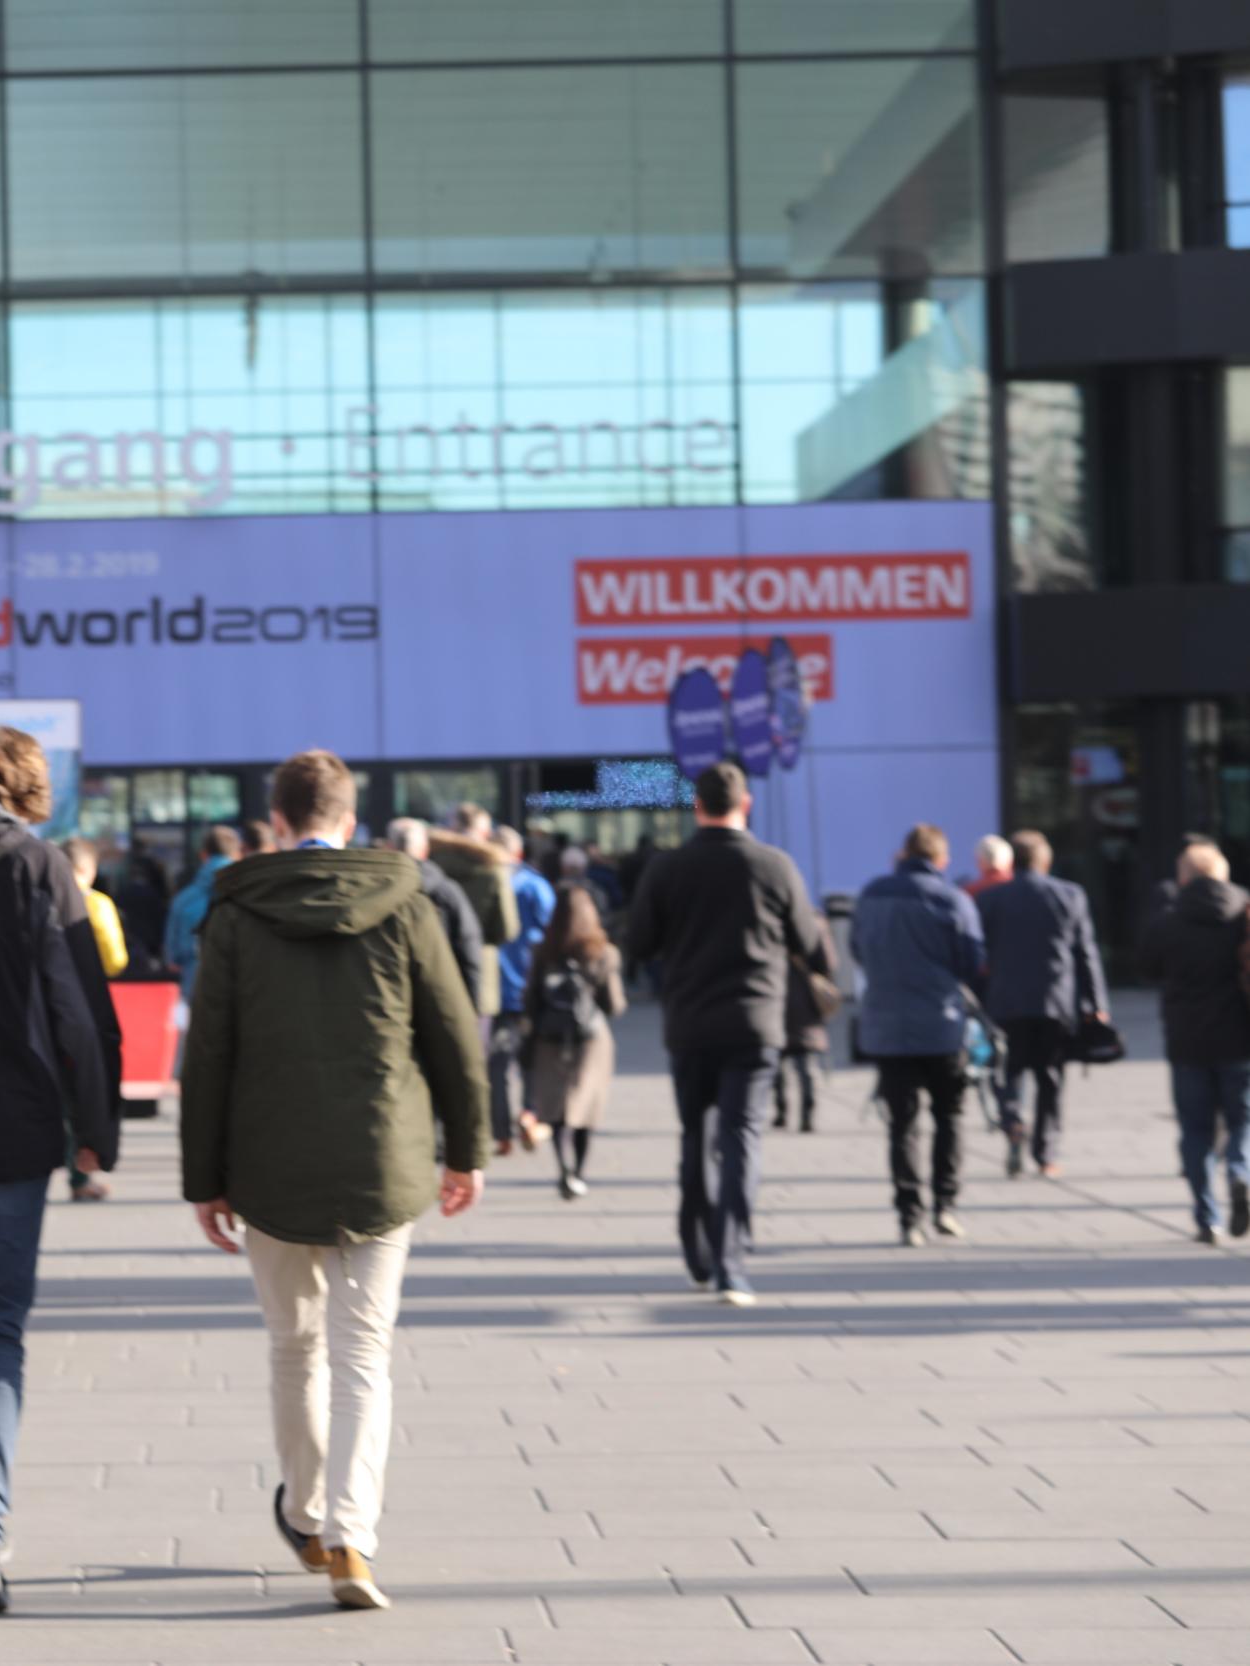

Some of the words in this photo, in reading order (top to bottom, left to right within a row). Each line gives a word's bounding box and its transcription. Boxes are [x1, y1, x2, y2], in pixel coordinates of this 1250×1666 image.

[347, 404, 730, 479] Entrance
[580, 563, 966, 615] WILLKOMMEN
[580, 645, 828, 694] Weloe
